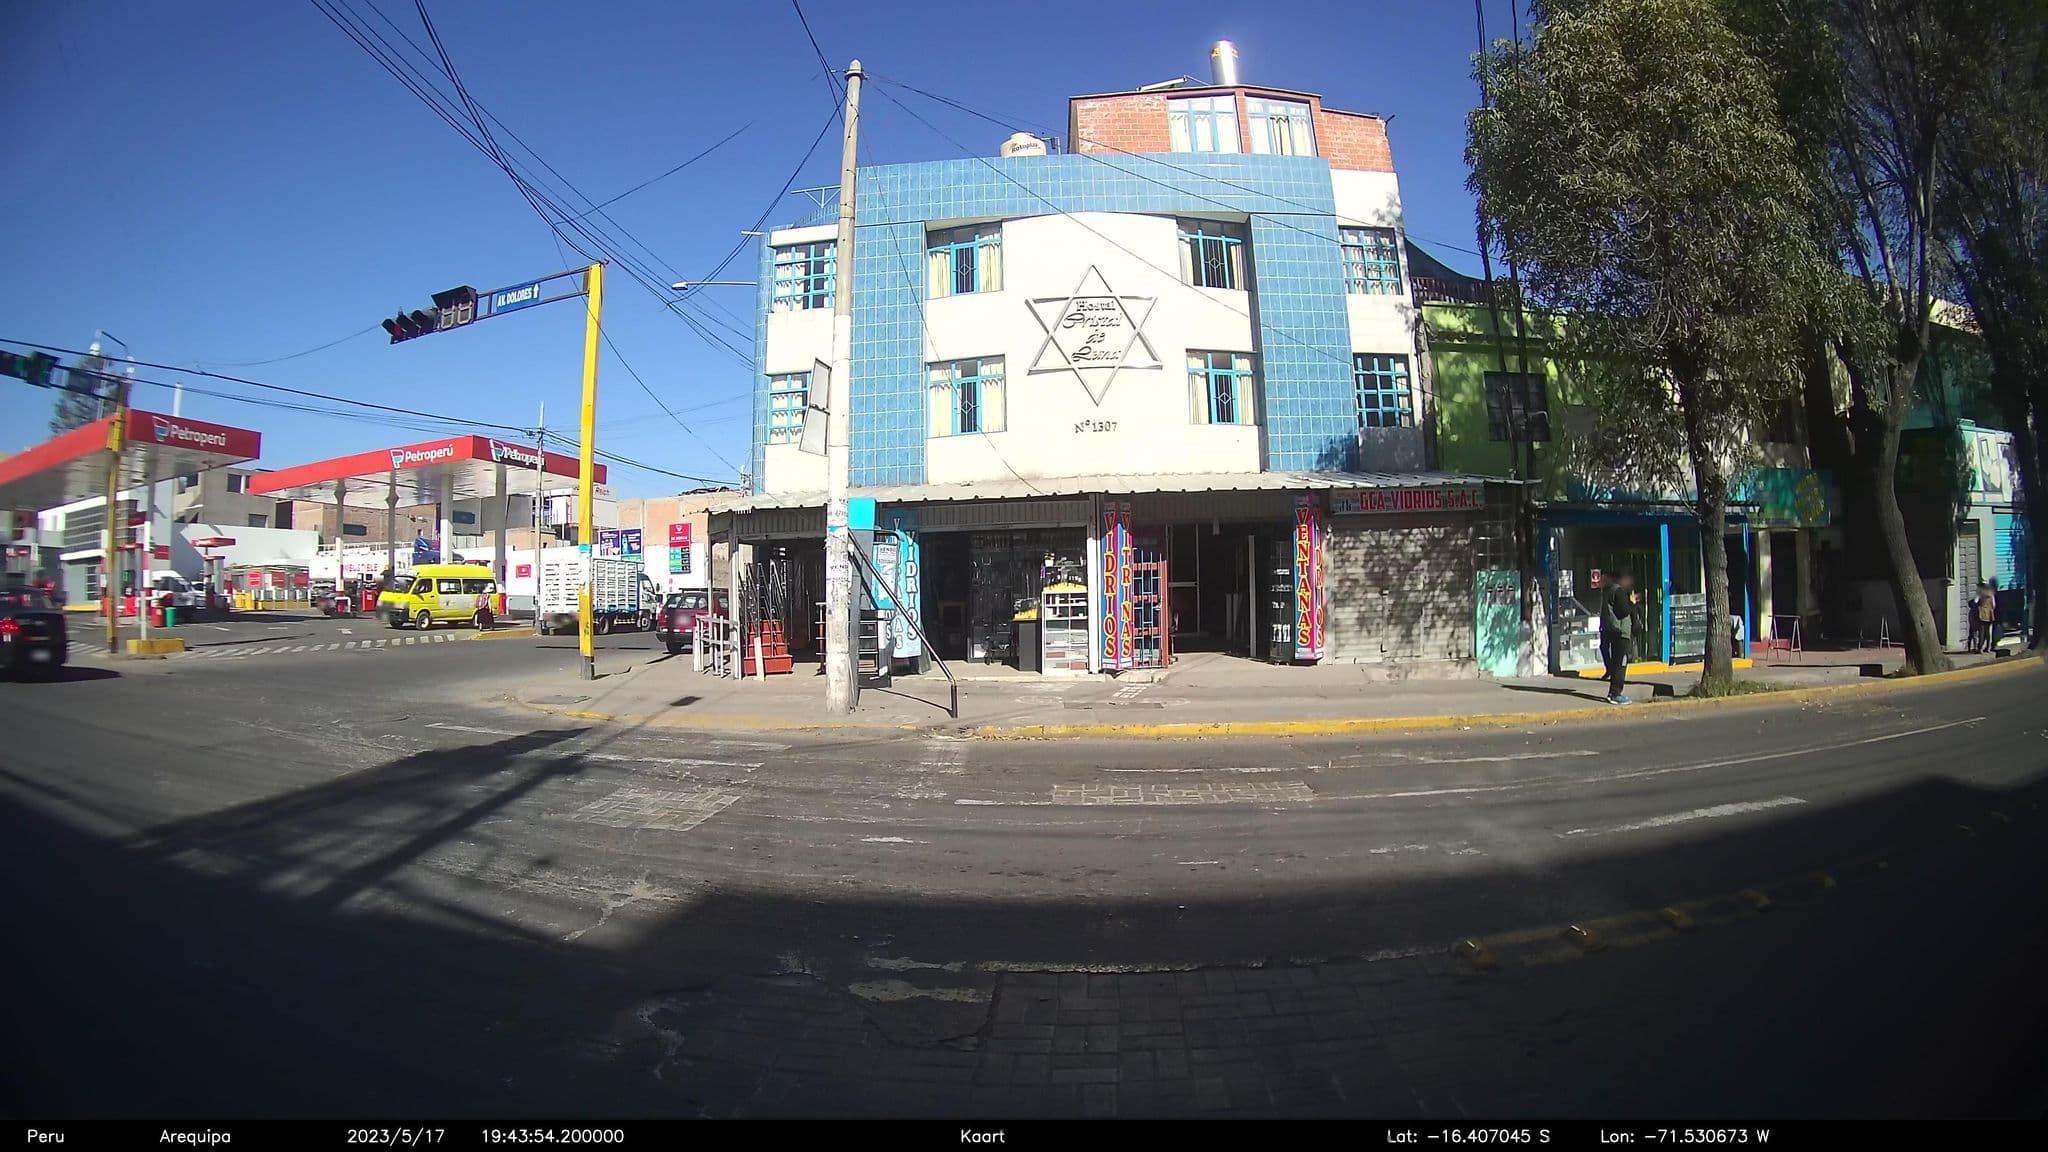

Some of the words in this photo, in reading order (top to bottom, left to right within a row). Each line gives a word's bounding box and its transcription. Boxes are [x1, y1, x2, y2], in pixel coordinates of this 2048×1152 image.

[506, 287, 532, 305] DOLORES
[1076, 301, 1116, 311] Hostal
[1063, 312, 1122, 329] Cristal
[1086, 329, 1106, 344] de
[170, 424, 226, 447] Petroperú
[405, 444, 453, 463] Petroperú
[1391, 489, 1442, 509] VIDRIOS
[1447, 488, 1482, 508] S.A.C.
[905, 531, 919, 640] VIDRIOS
[1103, 511, 1117, 657] VIDRIOS
[1120, 511, 1132, 657] VITRINAS
[1296, 508, 1311, 646] VENTANAS
